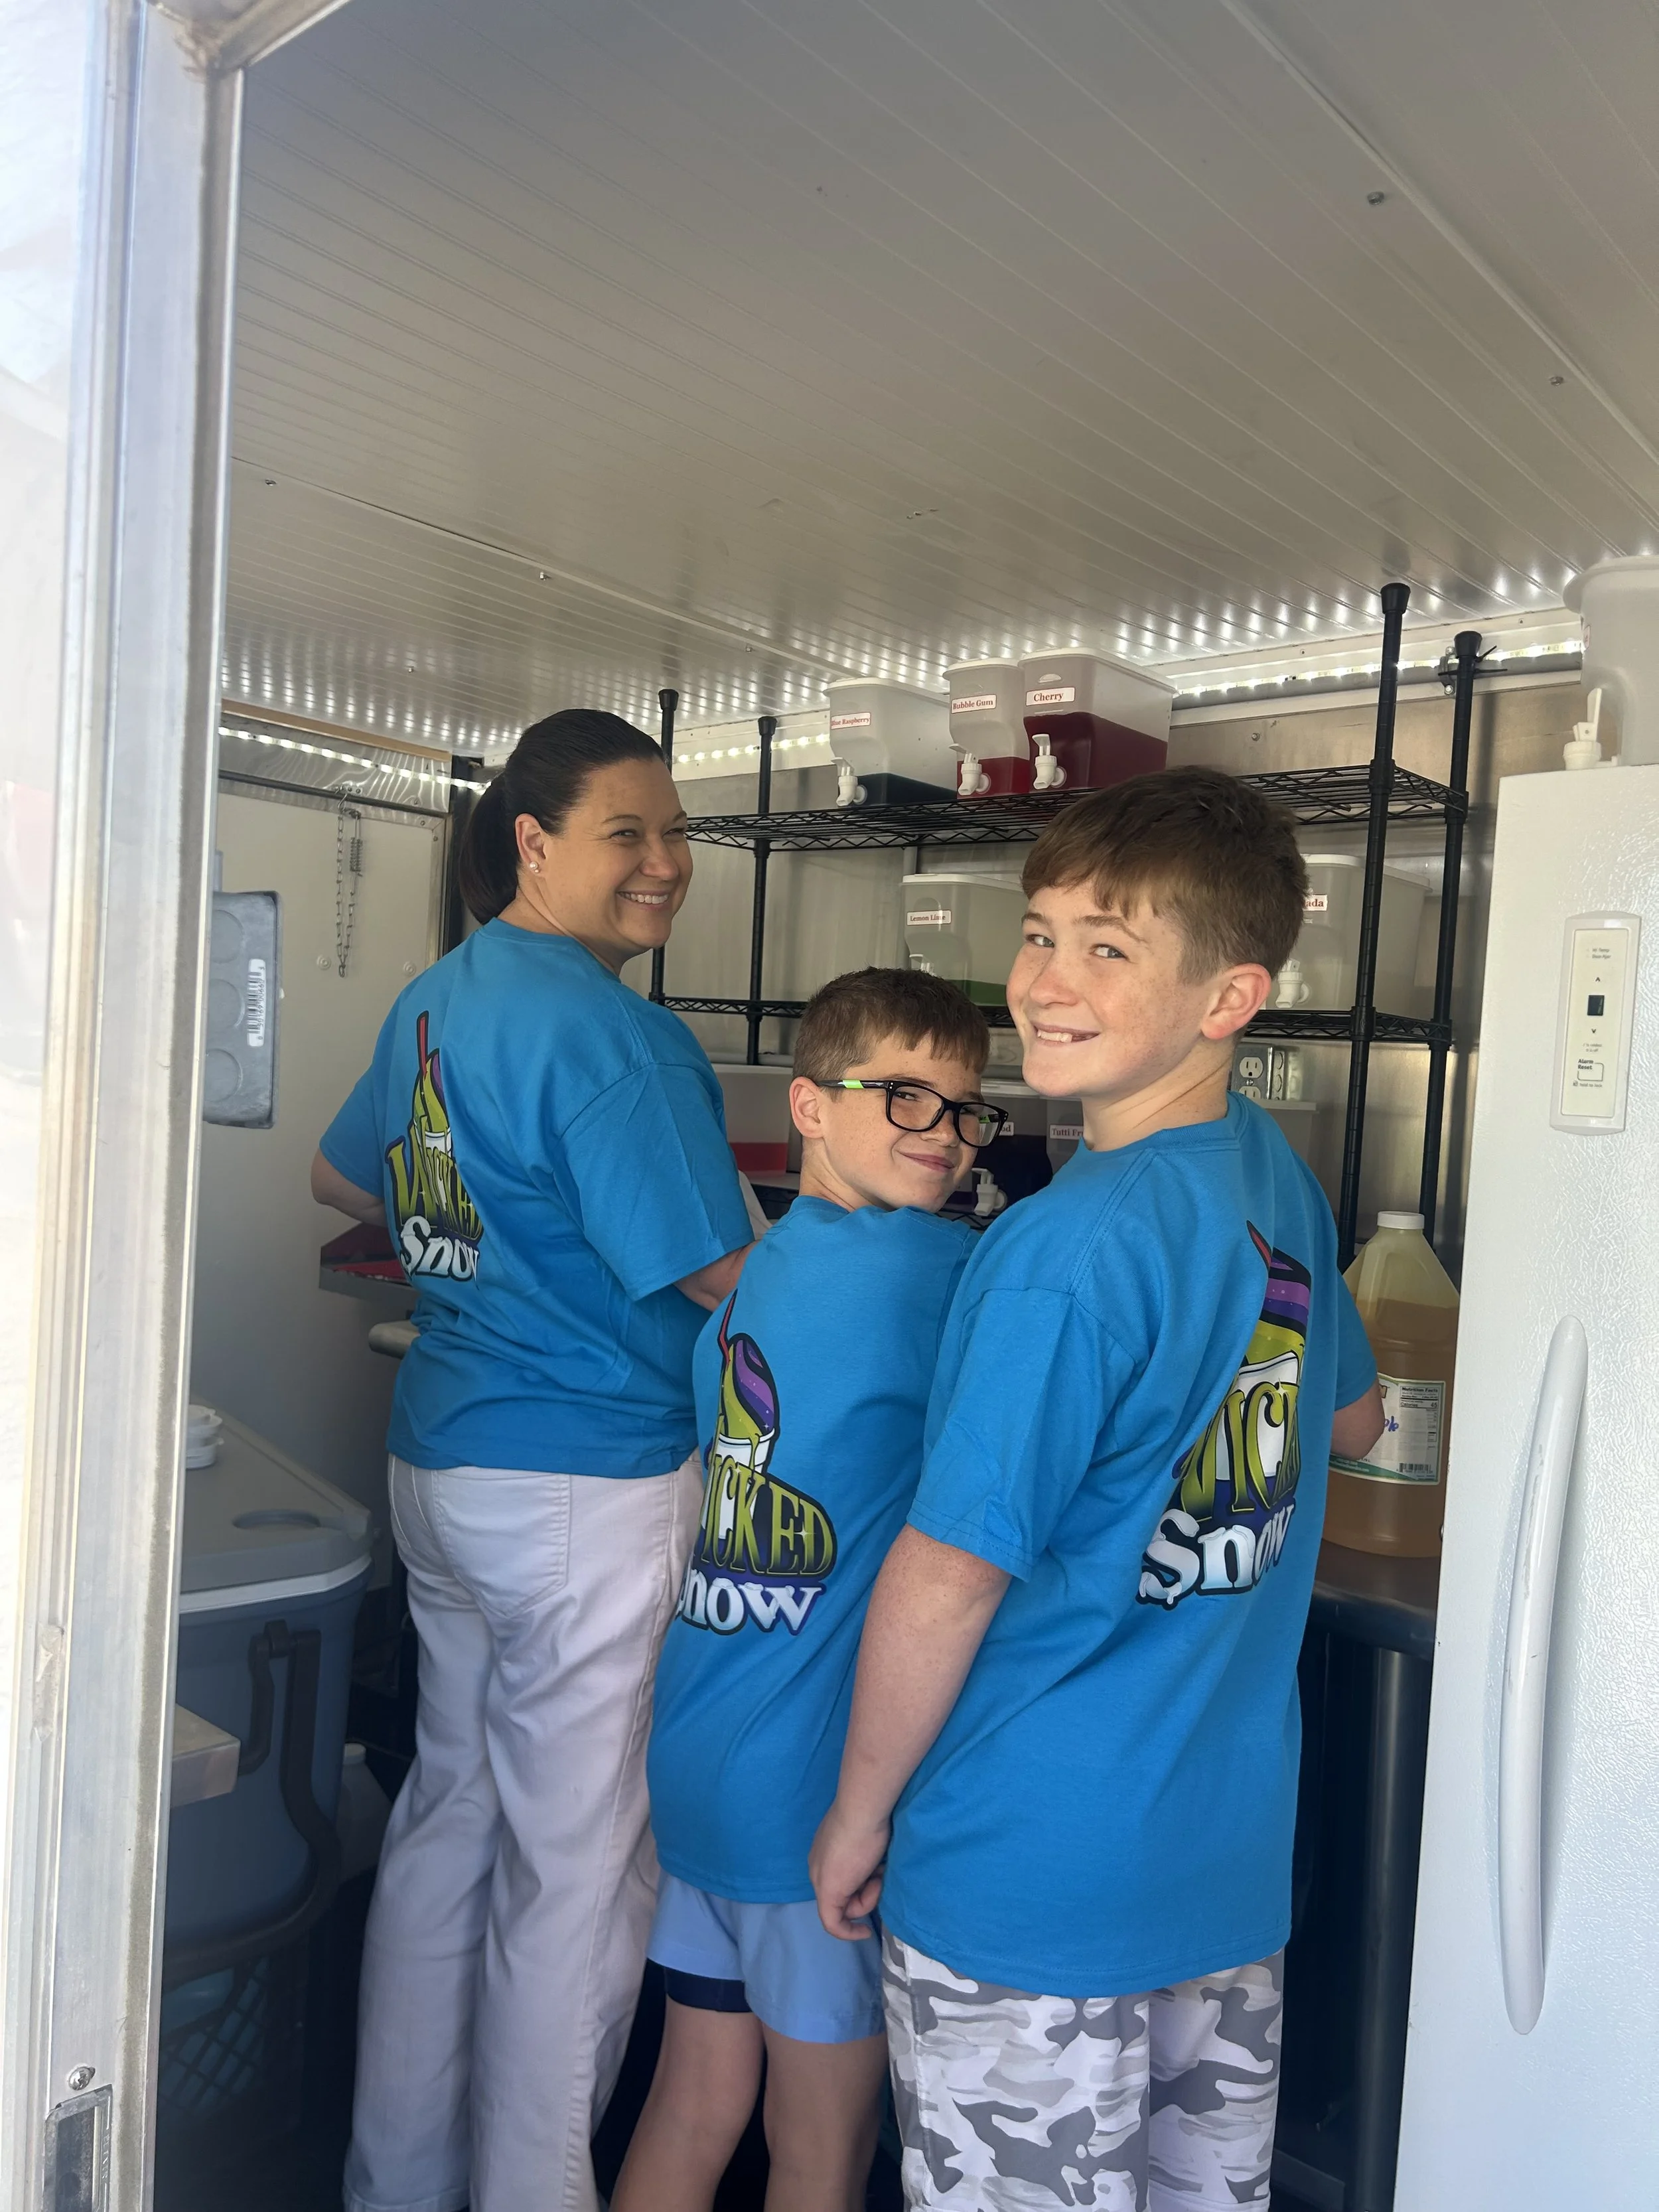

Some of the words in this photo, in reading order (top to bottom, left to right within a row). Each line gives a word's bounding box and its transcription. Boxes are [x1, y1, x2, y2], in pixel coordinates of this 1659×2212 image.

[1033, 692, 1064, 702] Cherry
[952, 700, 975, 710] Bubble
[842, 717, 870, 725] Raspberry
[1138, 1503, 1295, 1605] Snow
